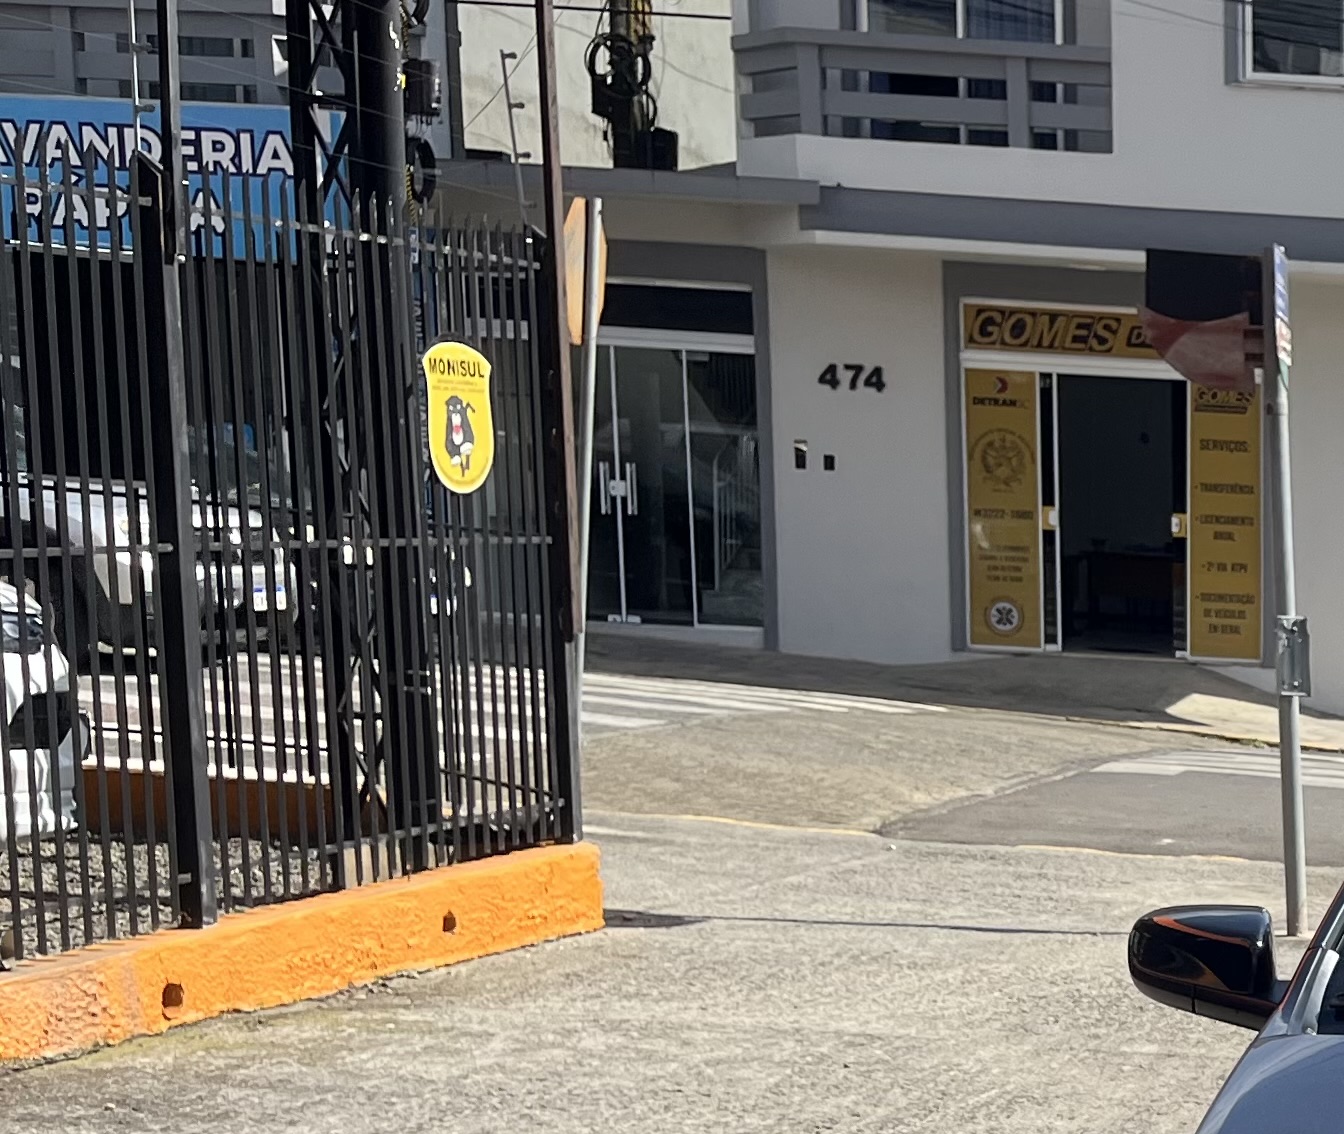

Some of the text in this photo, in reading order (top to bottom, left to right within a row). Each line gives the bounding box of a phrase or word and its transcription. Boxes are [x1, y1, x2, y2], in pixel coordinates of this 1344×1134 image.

[970, 309, 1122, 352] GOMES
[428, 357, 485, 379] MONISUL
[818, 363, 886, 392] 474
